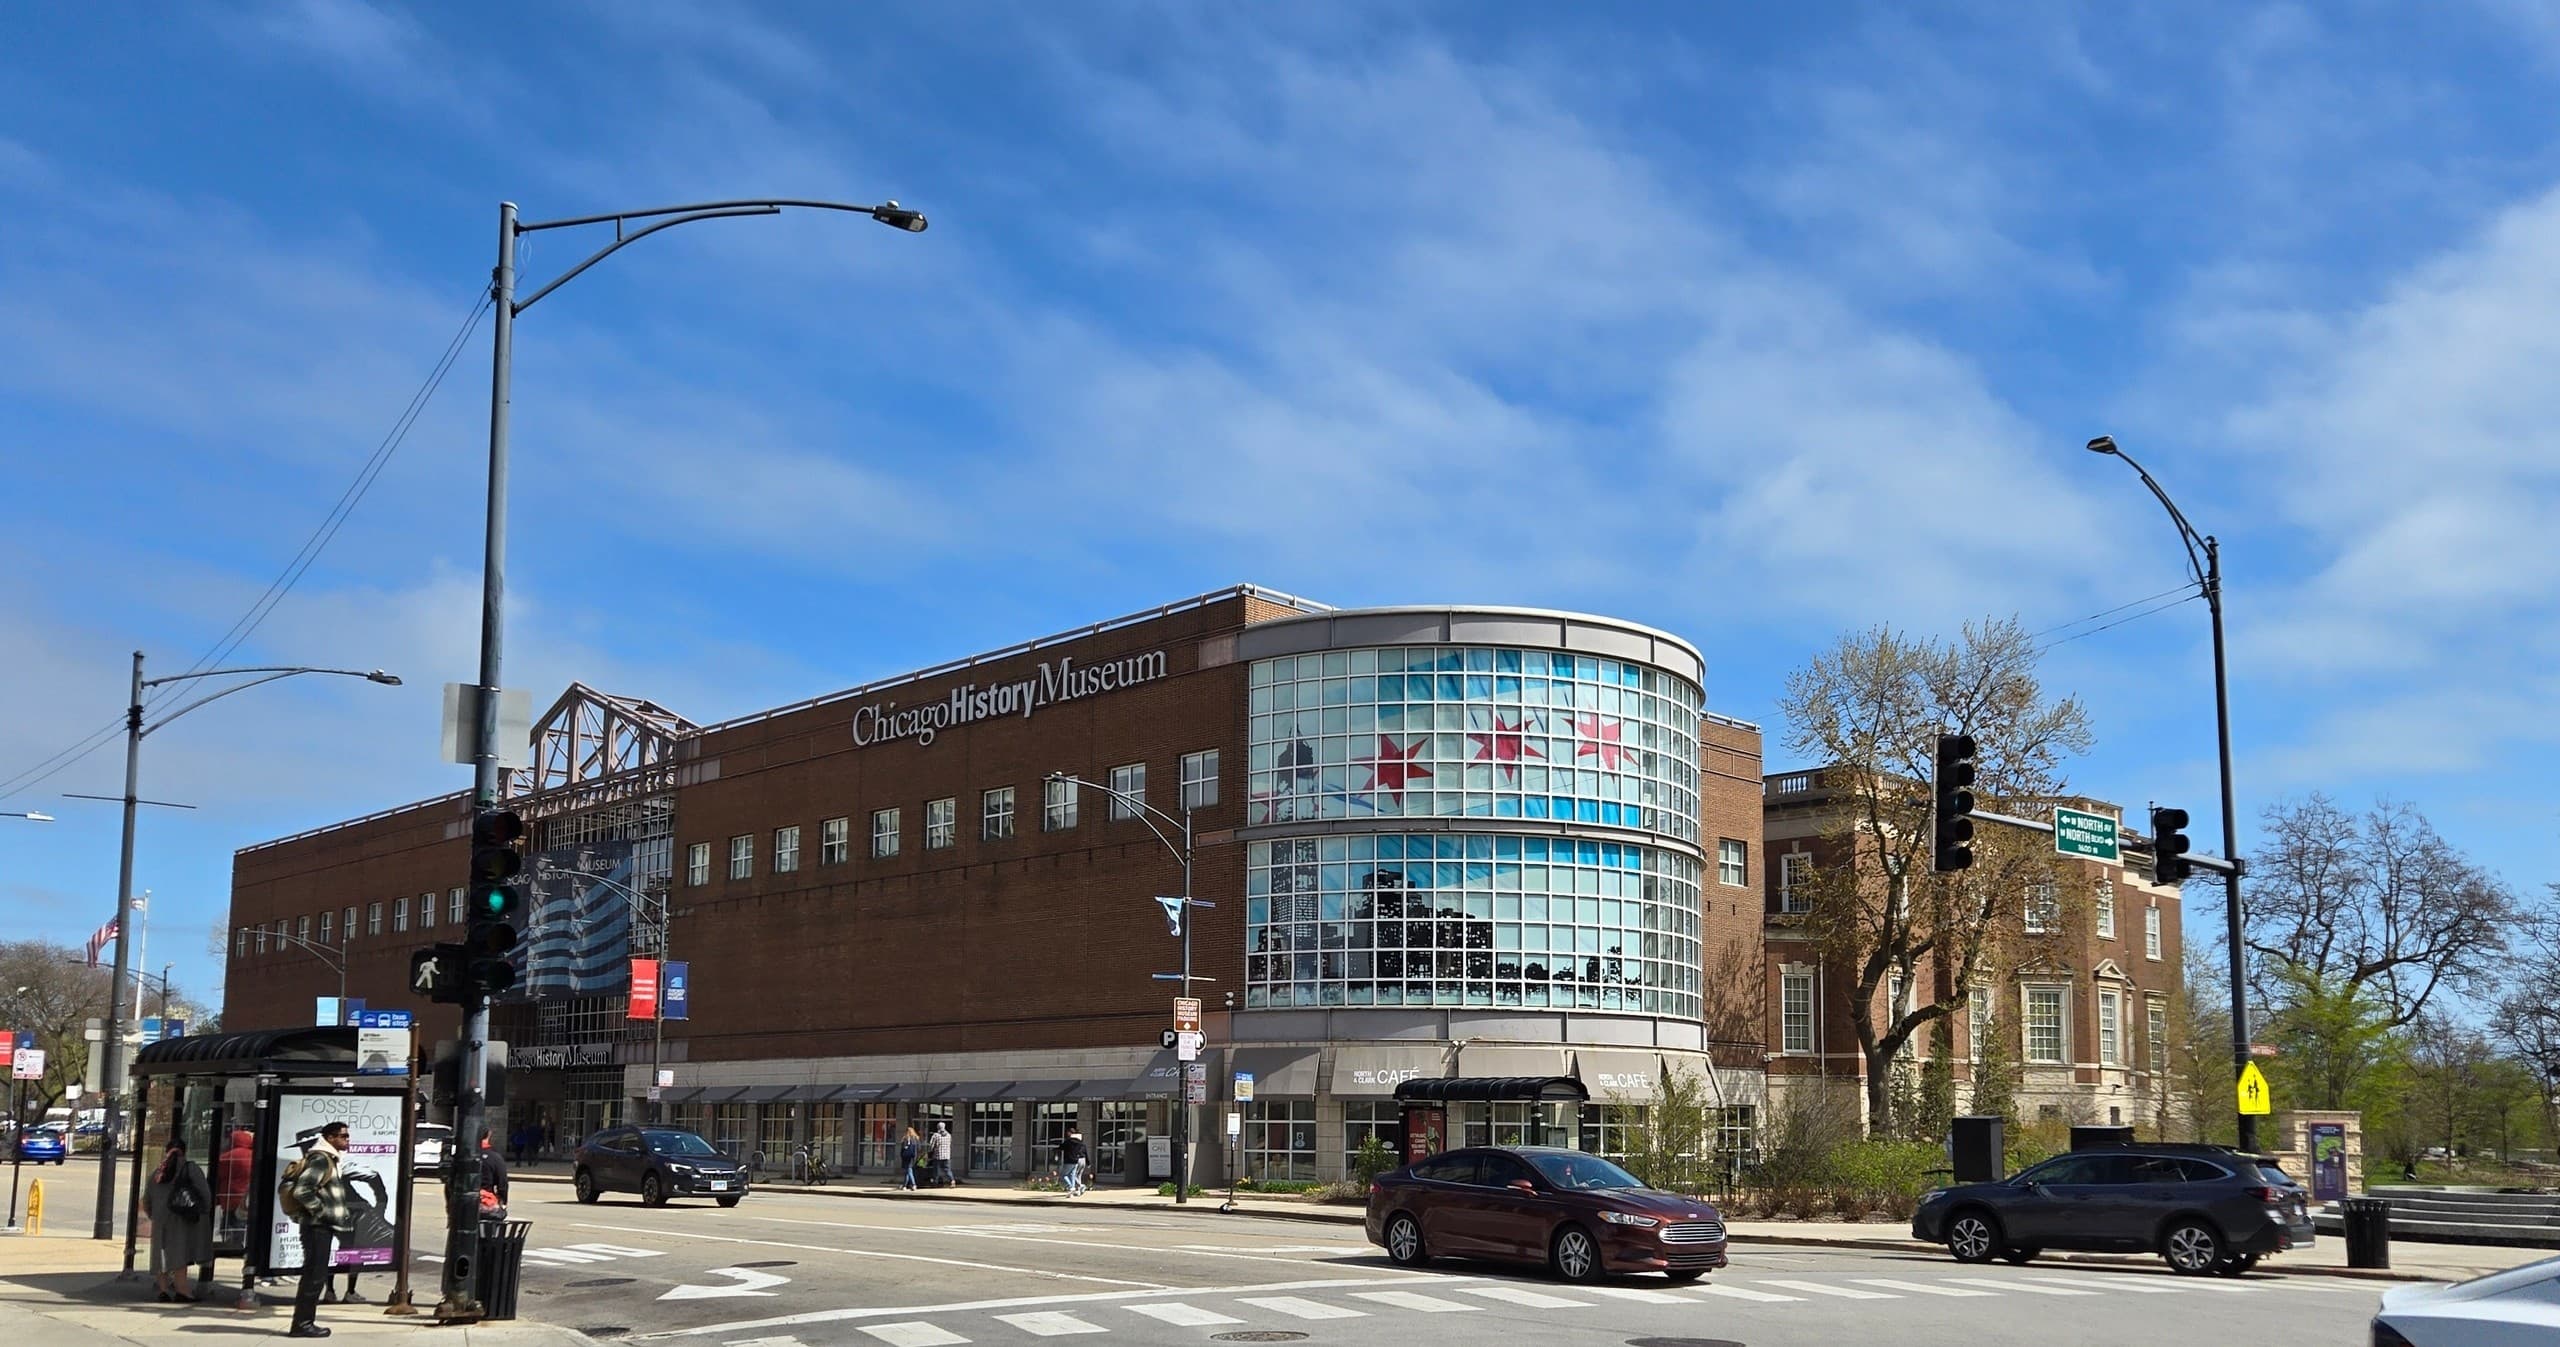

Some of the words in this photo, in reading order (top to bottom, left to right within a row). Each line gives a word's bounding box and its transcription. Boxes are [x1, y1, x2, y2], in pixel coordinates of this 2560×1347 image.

[2077, 817, 2104, 832] NORTH
[2065, 828, 2091, 843] NORTH
[577, 858, 621, 873] MUSEUM
[1163, 1031, 1176, 1046] P
[509, 1048, 537, 1073] hicago
[1377, 1066, 1420, 1084] CAFÉ
[1617, 1071, 1650, 1089] CAFÉ
[301, 1098, 369, 1114] FOSSE/
[349, 1145, 368, 1153] MAY
